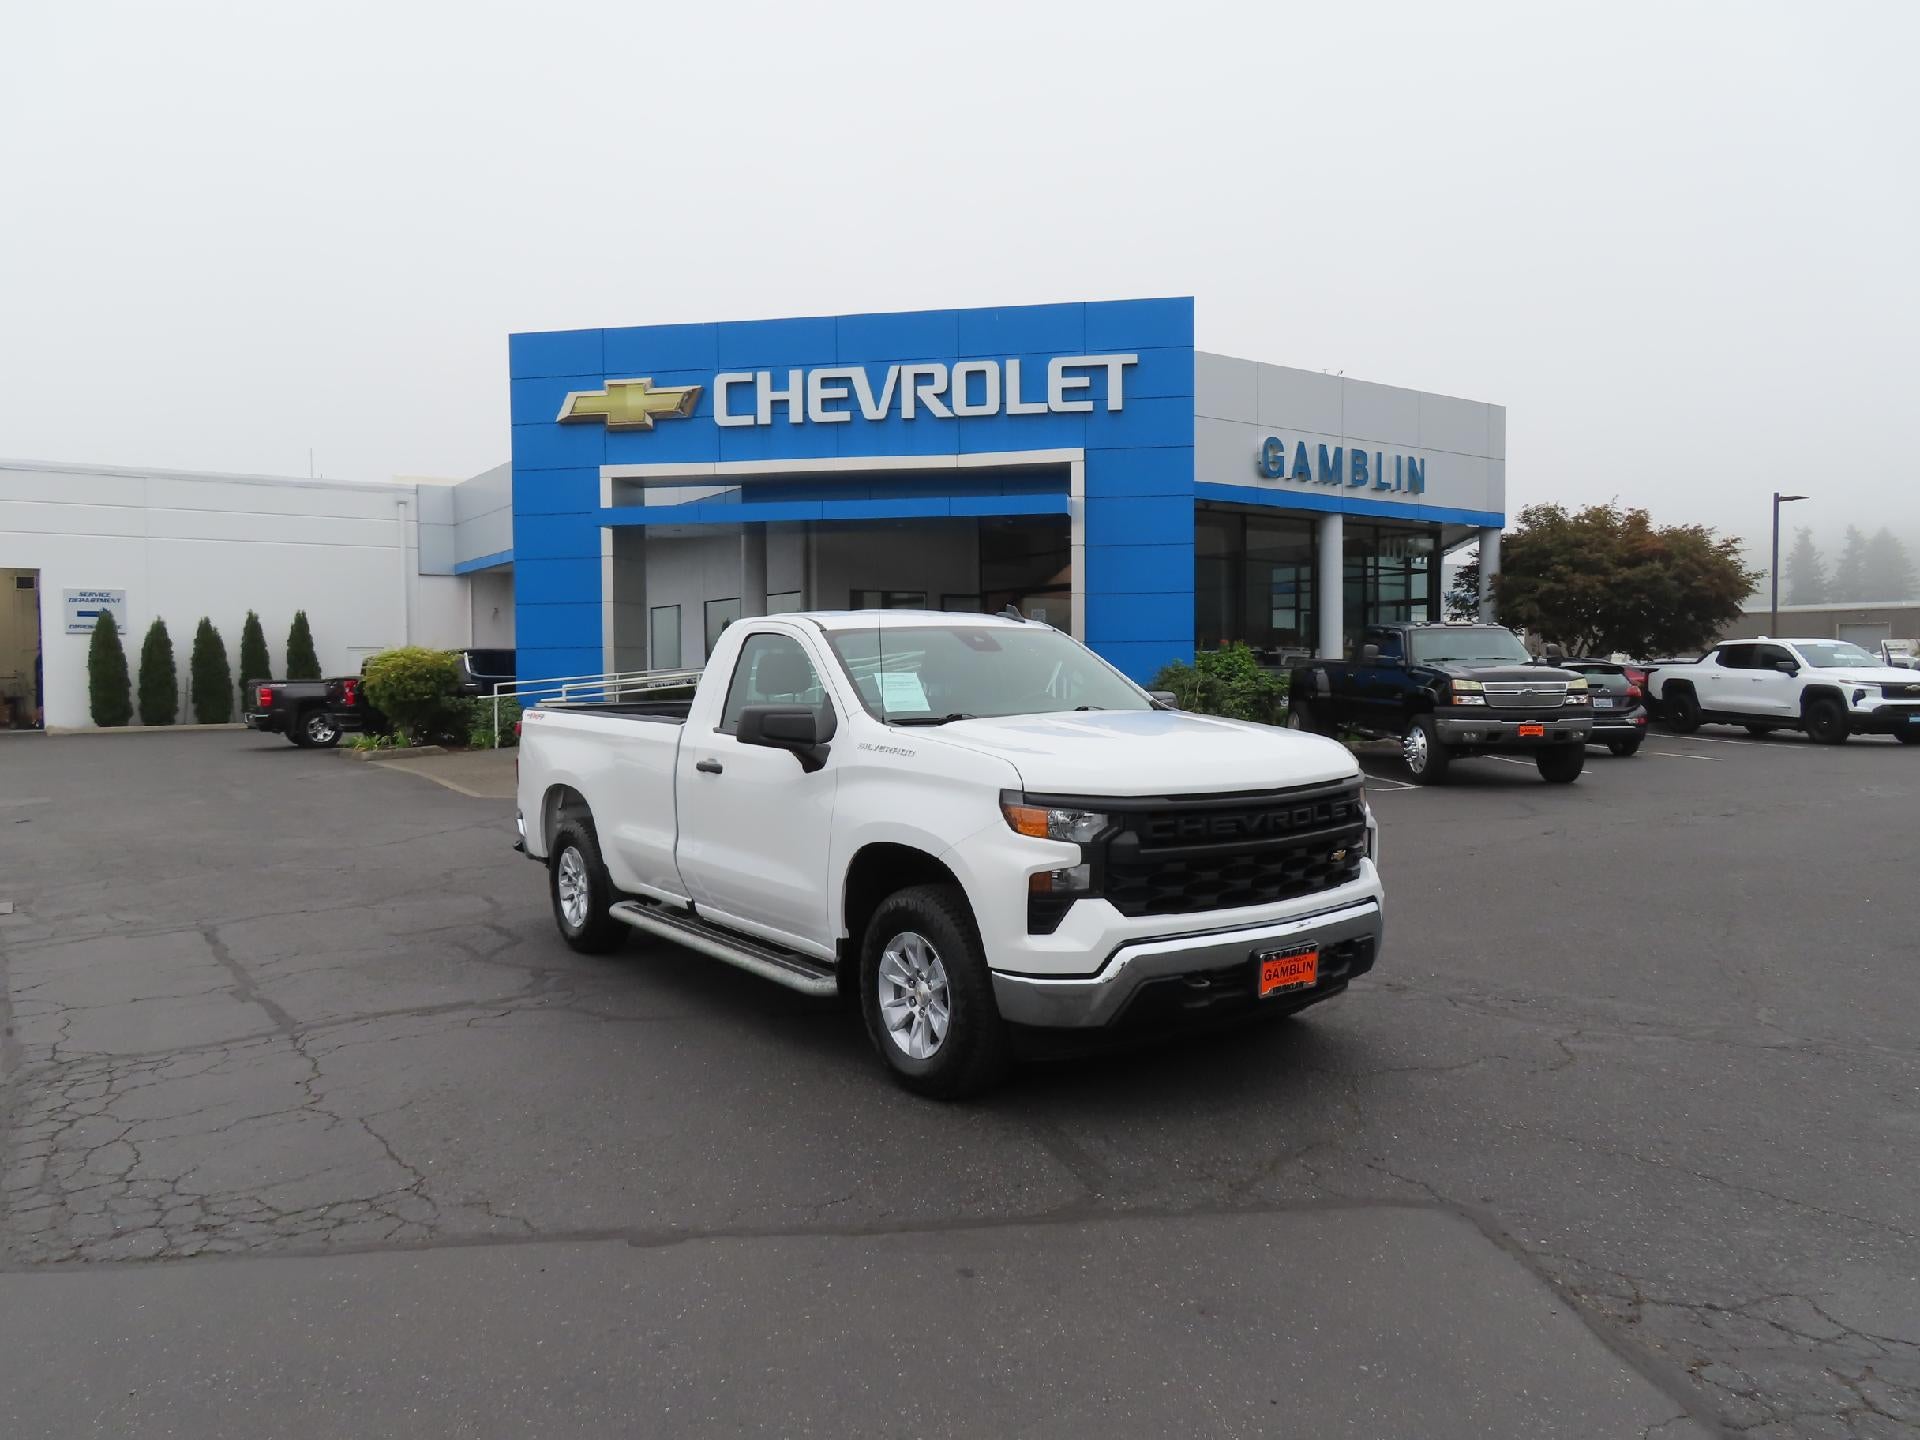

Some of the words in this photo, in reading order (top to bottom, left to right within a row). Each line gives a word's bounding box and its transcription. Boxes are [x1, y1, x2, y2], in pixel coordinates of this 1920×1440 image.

[713, 353, 1139, 427] CHEVROLET
[1261, 436, 1425, 494] GAMBLIN
[1264, 961, 1314, 982] GAMBLIN
